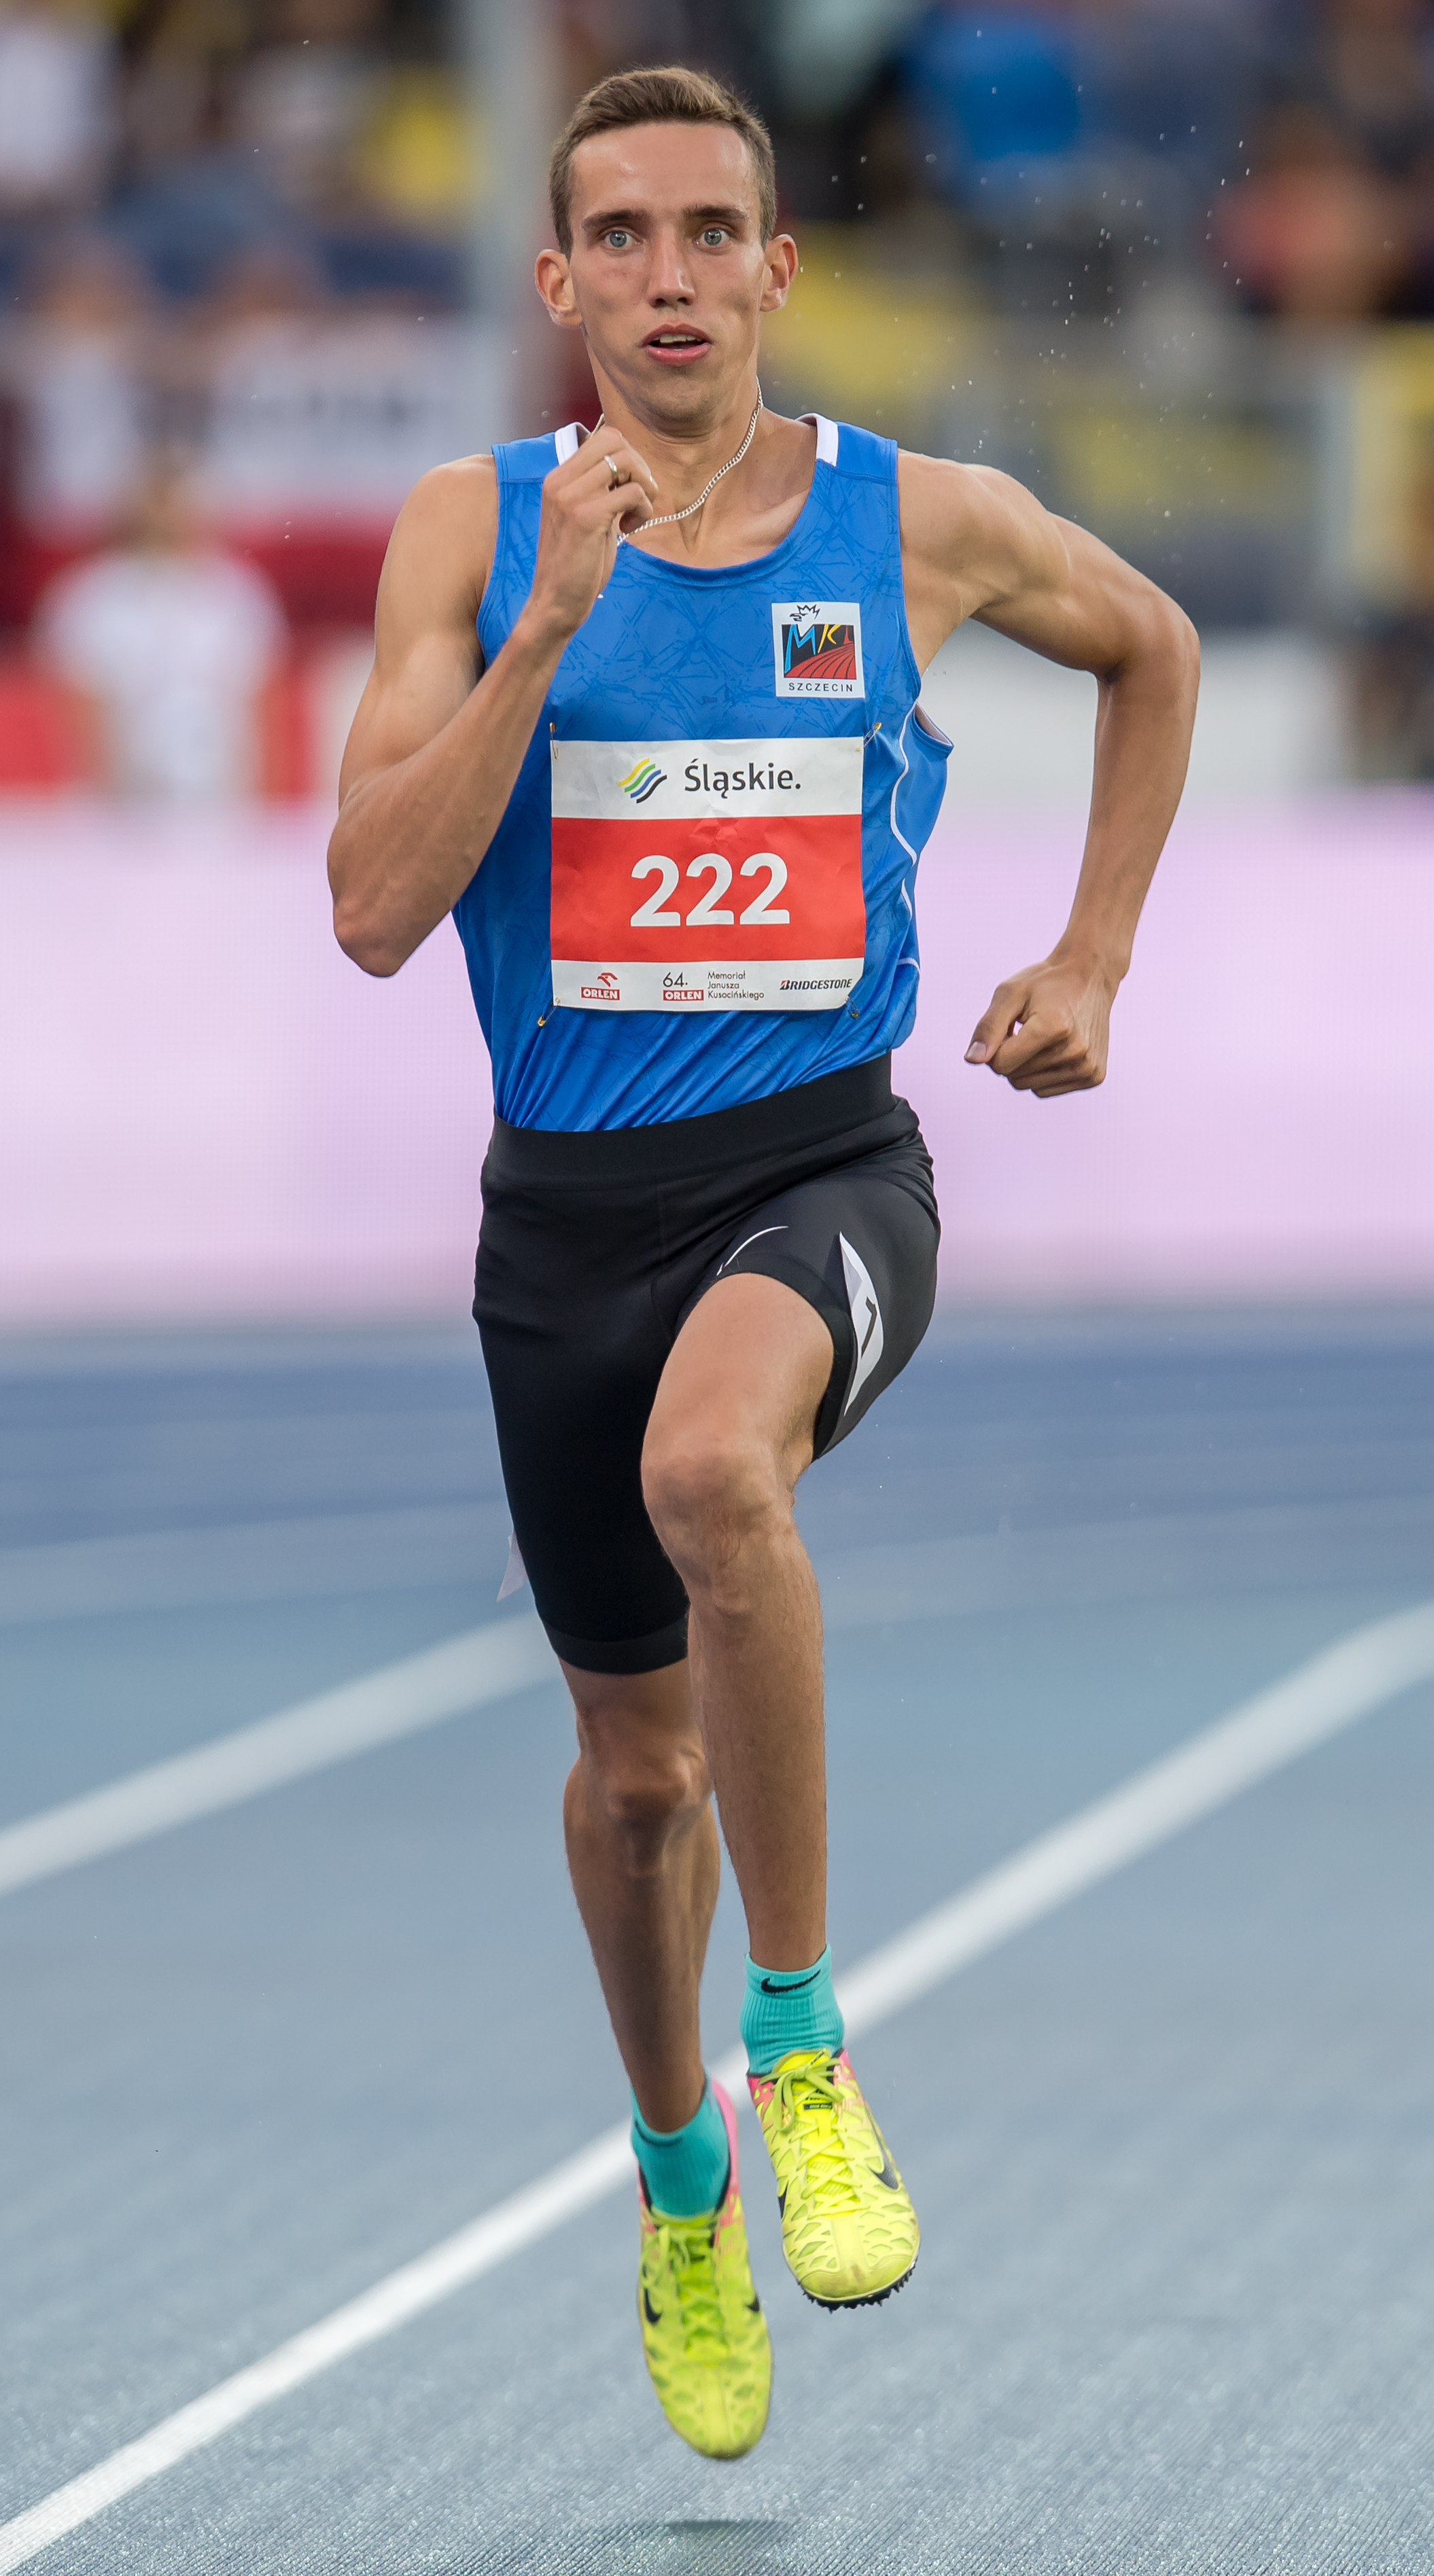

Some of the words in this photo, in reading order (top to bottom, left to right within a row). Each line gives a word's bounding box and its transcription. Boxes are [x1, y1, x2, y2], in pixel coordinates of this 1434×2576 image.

[788, 682, 853, 692] SZCZECIN
[684, 758, 801, 798] Śląskie.
[630, 852, 790, 927] 222
[663, 972, 688, 987] 64.
[707, 970, 746, 979] Memoriał
[779, 978, 853, 991] BRIDGESTONE
[582, 989, 618, 1000] ORLEN
[665, 991, 701, 1000] ORLEN
[707, 989, 765, 1000] Kusocińskiego
